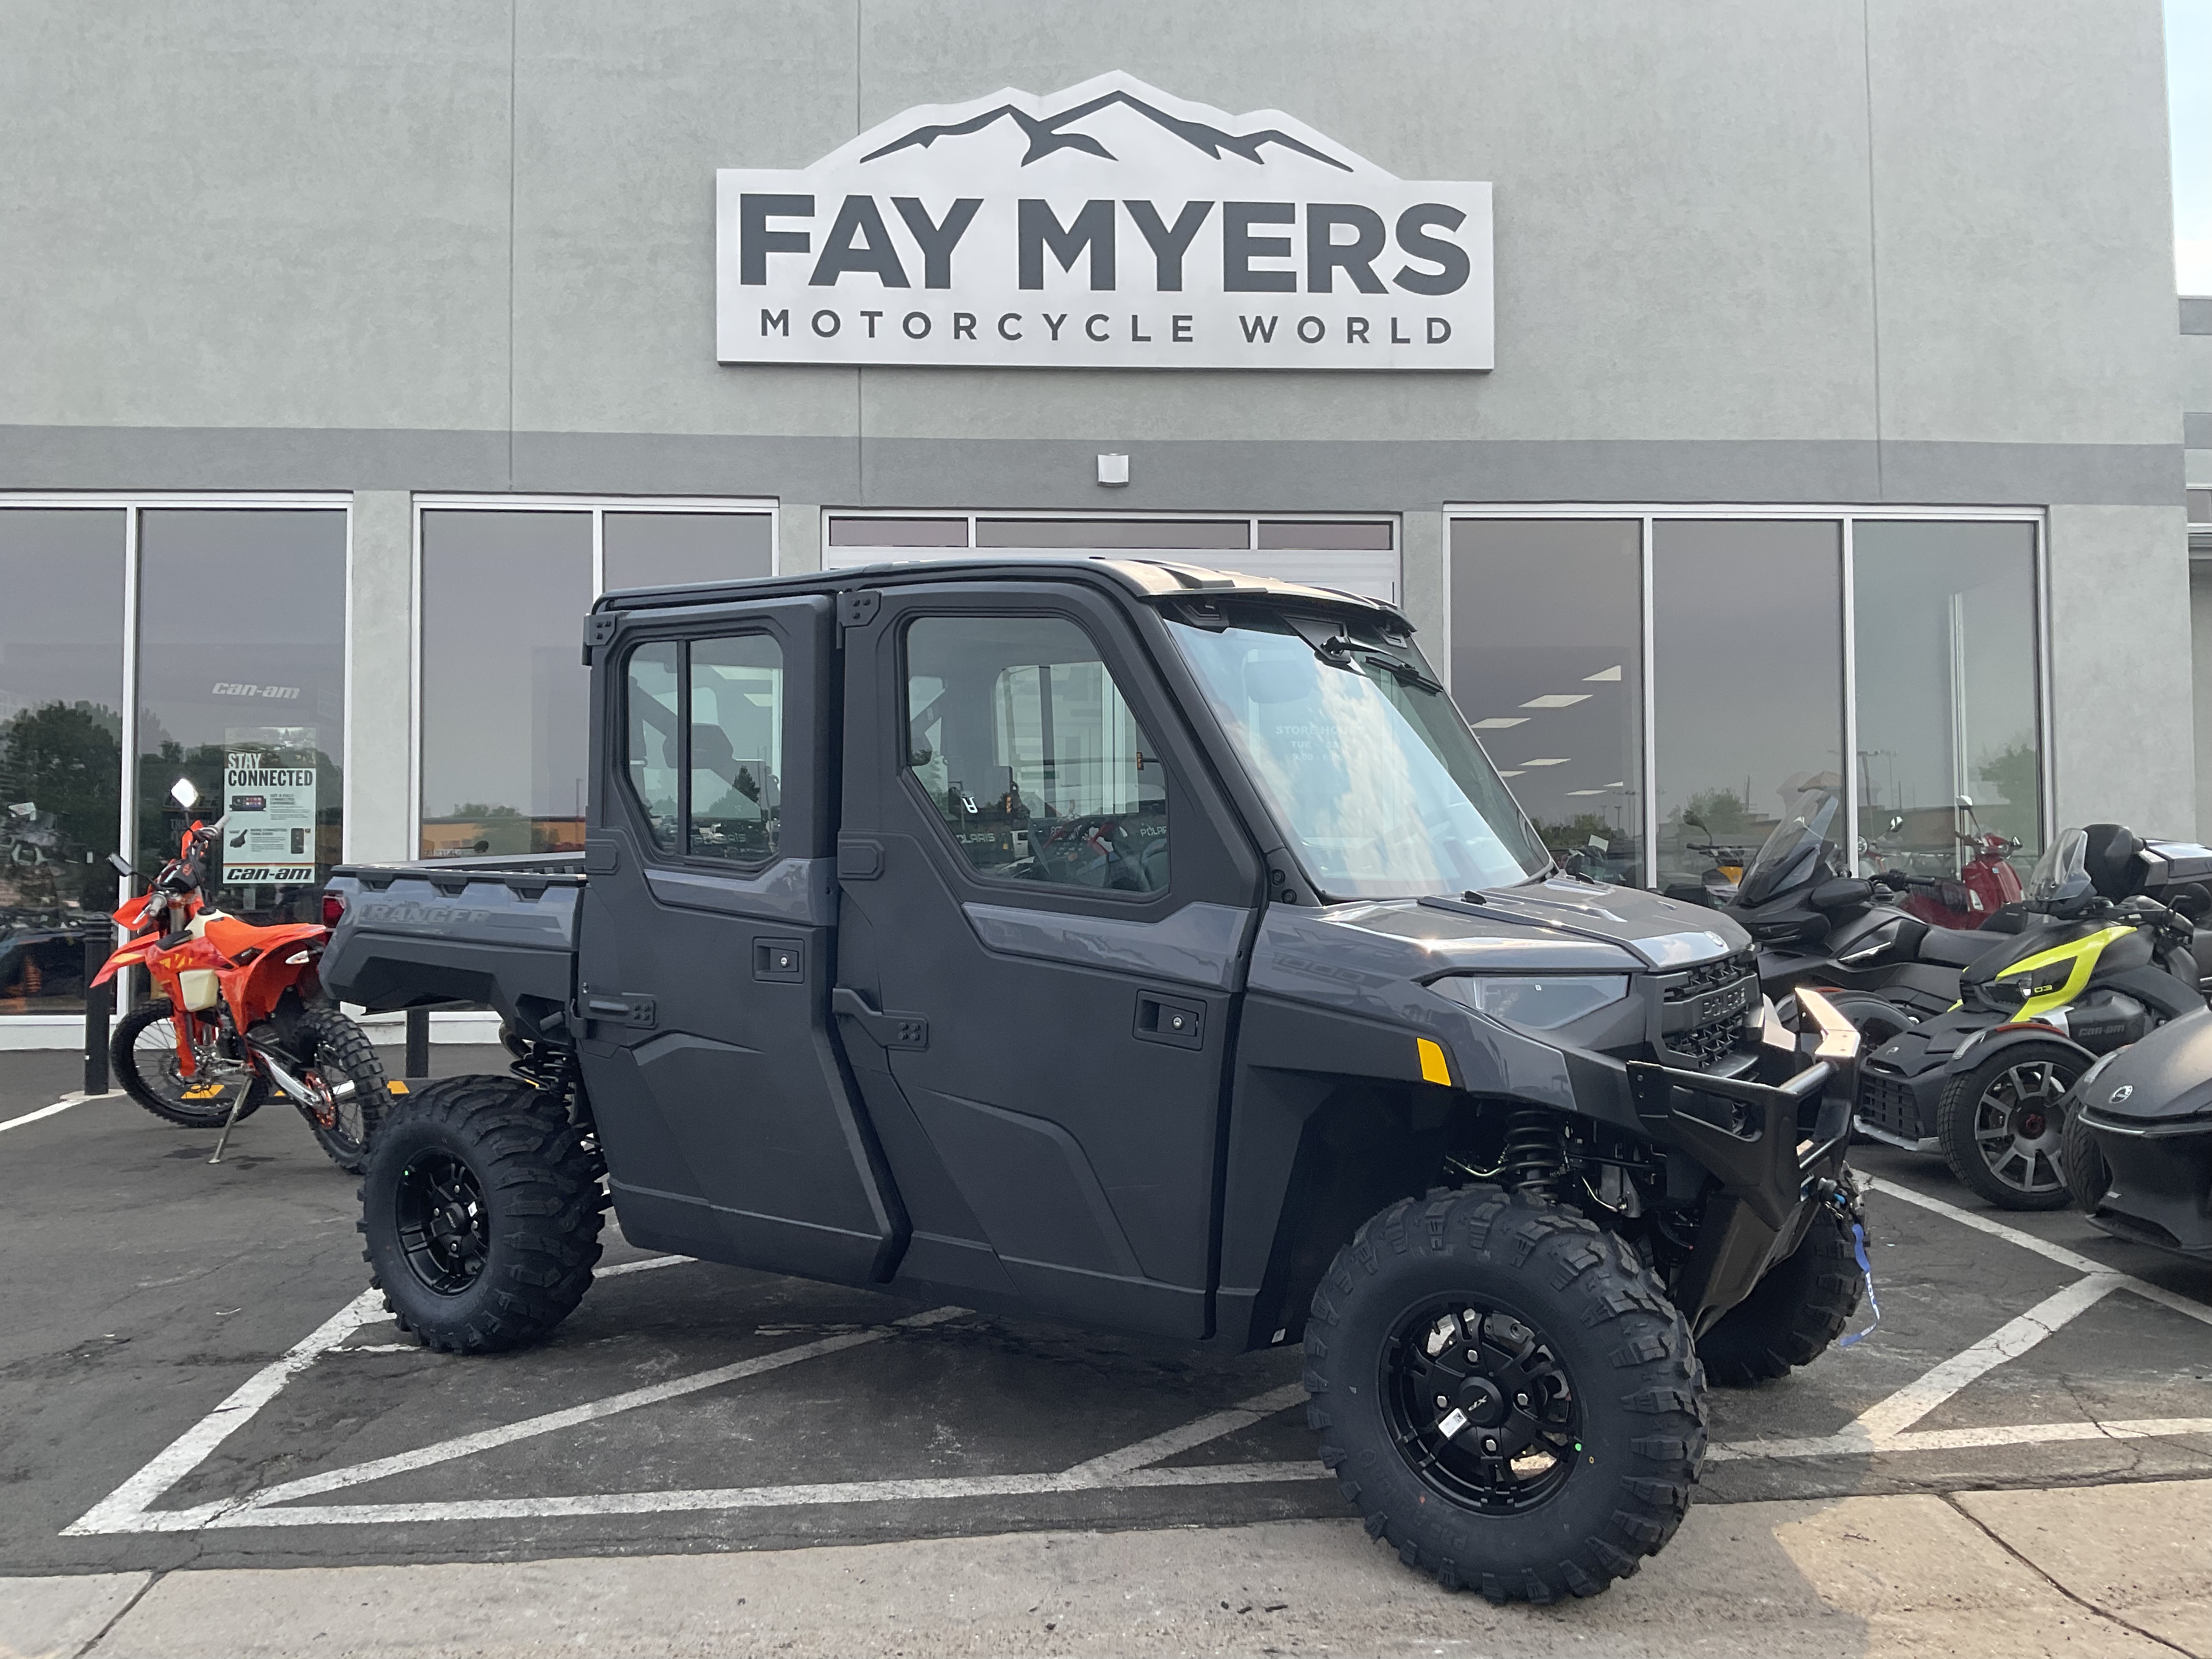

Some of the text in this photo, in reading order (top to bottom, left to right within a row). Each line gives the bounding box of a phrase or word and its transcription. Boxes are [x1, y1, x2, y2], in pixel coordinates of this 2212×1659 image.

[741, 193, 1470, 296] FAY MYERS
[761, 309, 1452, 344] MOTORCYCLE WORLD
[212, 682, 300, 699] can-am
[228, 753, 263, 769] STAY
[228, 770, 313, 786] CONNECTED
[956, 832, 995, 844] OLARIS
[227, 868, 312, 880] can-am
[2034, 985, 2052, 994] 03
[2079, 1025, 2125, 1037] can-am
[1468, 1395, 1487, 1412] XP
